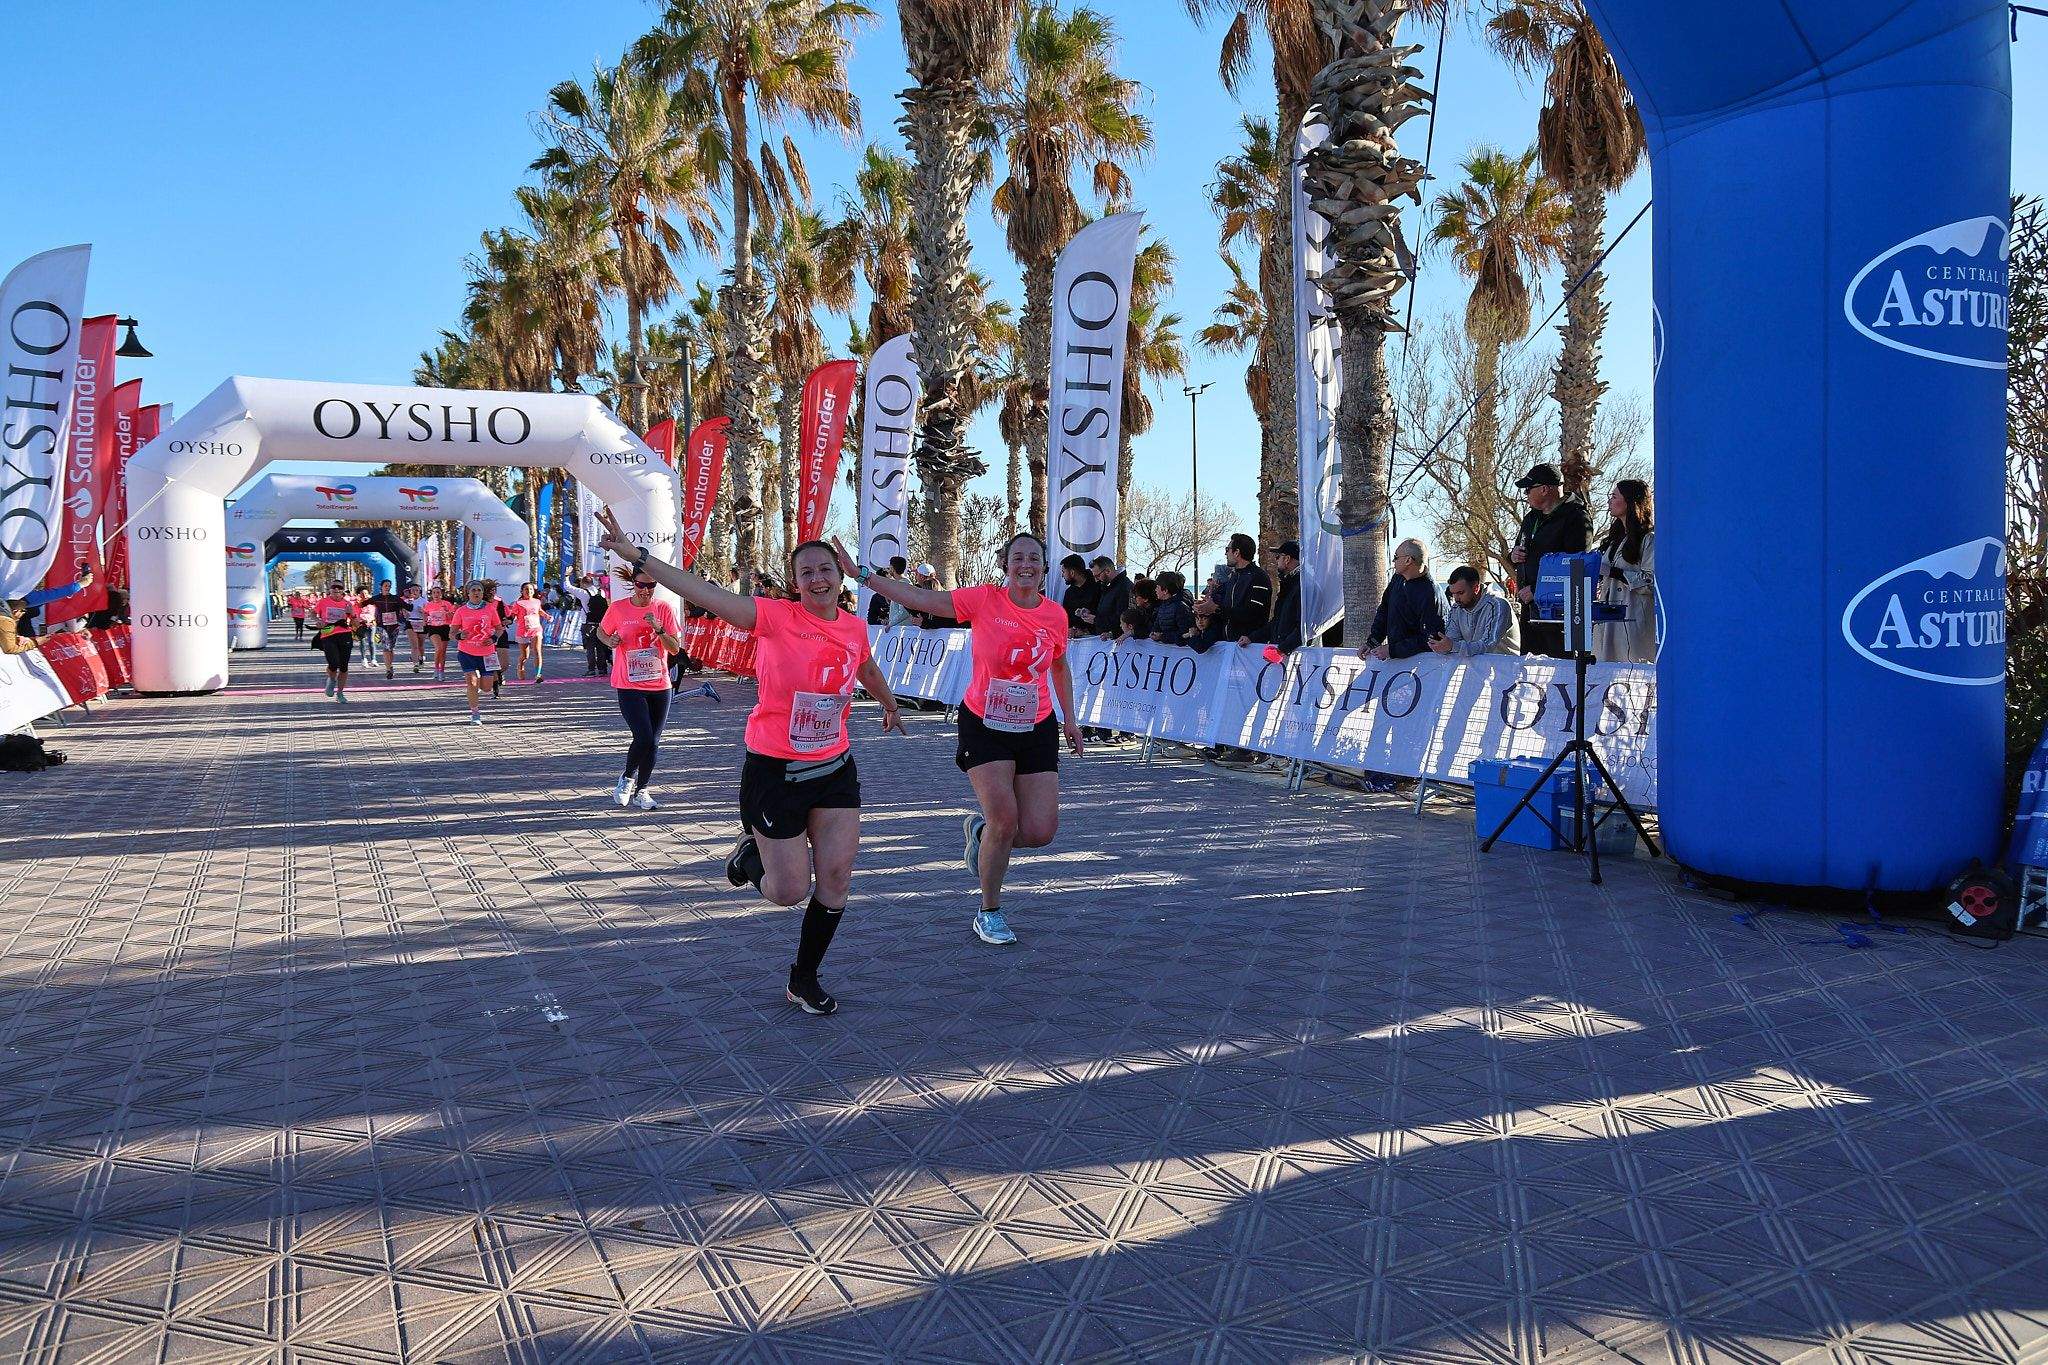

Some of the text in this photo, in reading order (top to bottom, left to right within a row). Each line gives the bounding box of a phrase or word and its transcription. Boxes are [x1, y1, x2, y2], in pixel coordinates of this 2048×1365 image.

[1926, 265, 1999, 283] CENTRAL
[69, 354, 97, 484] Santander
[313, 398, 531, 446] OYSHO
[1056, 270, 1119, 554] OYSHO
[0, 300, 71, 561] OYSHO
[809, 387, 837, 497] Santander
[168, 440, 242, 457] OYSHO
[589, 452, 648, 466] OYSHO
[690, 440, 715, 520] Santander
[868, 374, 914, 572] OYSHO
[138, 526, 207, 541] OYSHO
[286, 535, 372, 544] VOLVO
[1923, 589, 1995, 604] CENTRAL
[140, 613, 209, 629] OYSHO
[993, 616, 1019, 628] OYSHO
[885, 635, 945, 668] OYSHO
[1085, 651, 1197, 696] OYSHO
[1255, 661, 1422, 718] OYSHO
[1005, 703, 1026, 714] 016
[813, 718, 832, 730] 016
